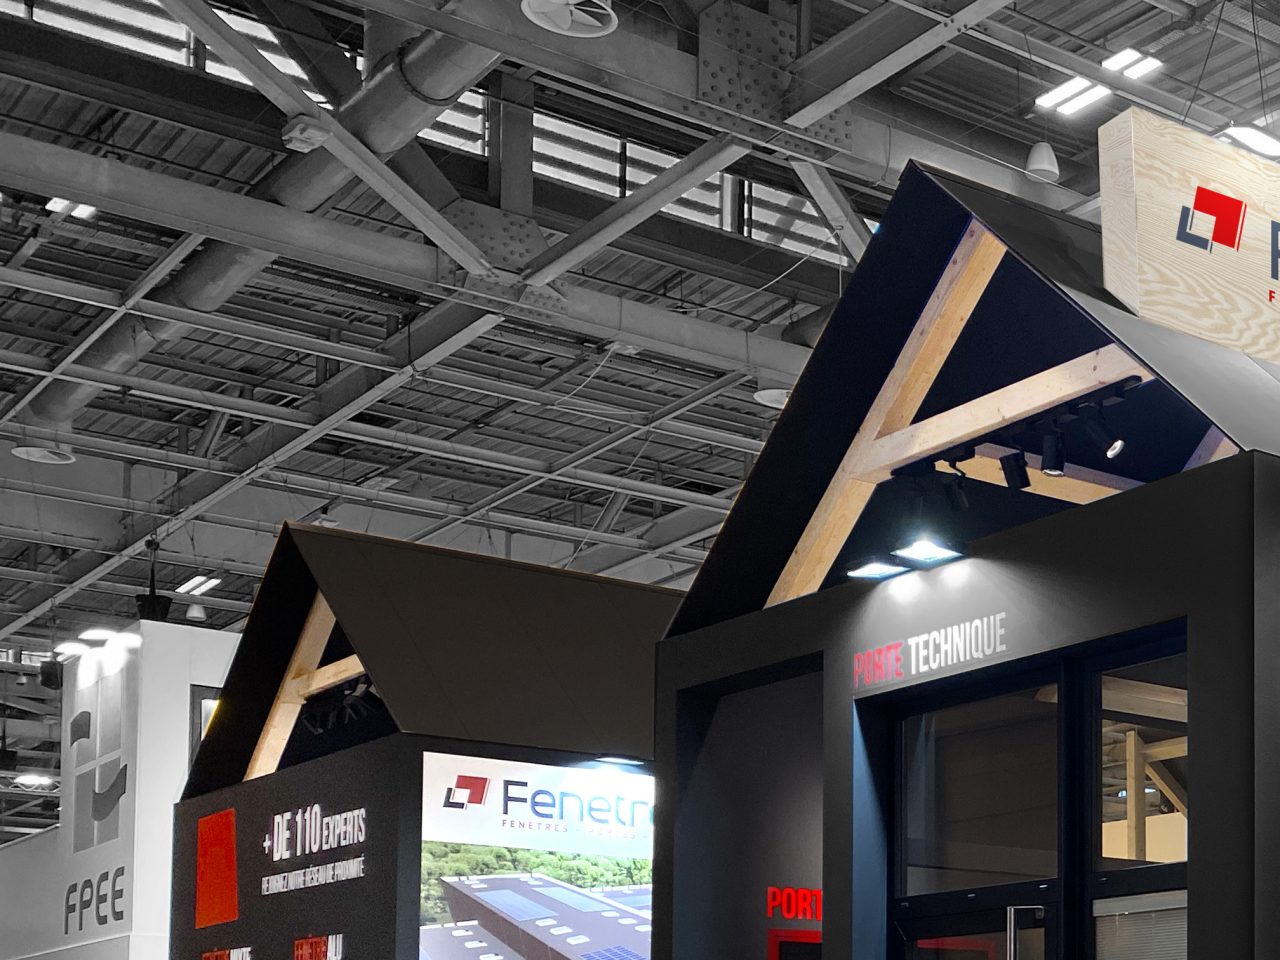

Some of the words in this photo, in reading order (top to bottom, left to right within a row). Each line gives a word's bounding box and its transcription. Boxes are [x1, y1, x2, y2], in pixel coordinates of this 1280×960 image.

[853, 640, 904, 688] PORTE
[907, 611, 1007, 675] TECHNIQUE
[272, 811, 292, 862] DE
[295, 804, 321, 857] 110
[322, 808, 366, 850] EXPERTS
[64, 866, 126, 935] FPEE
